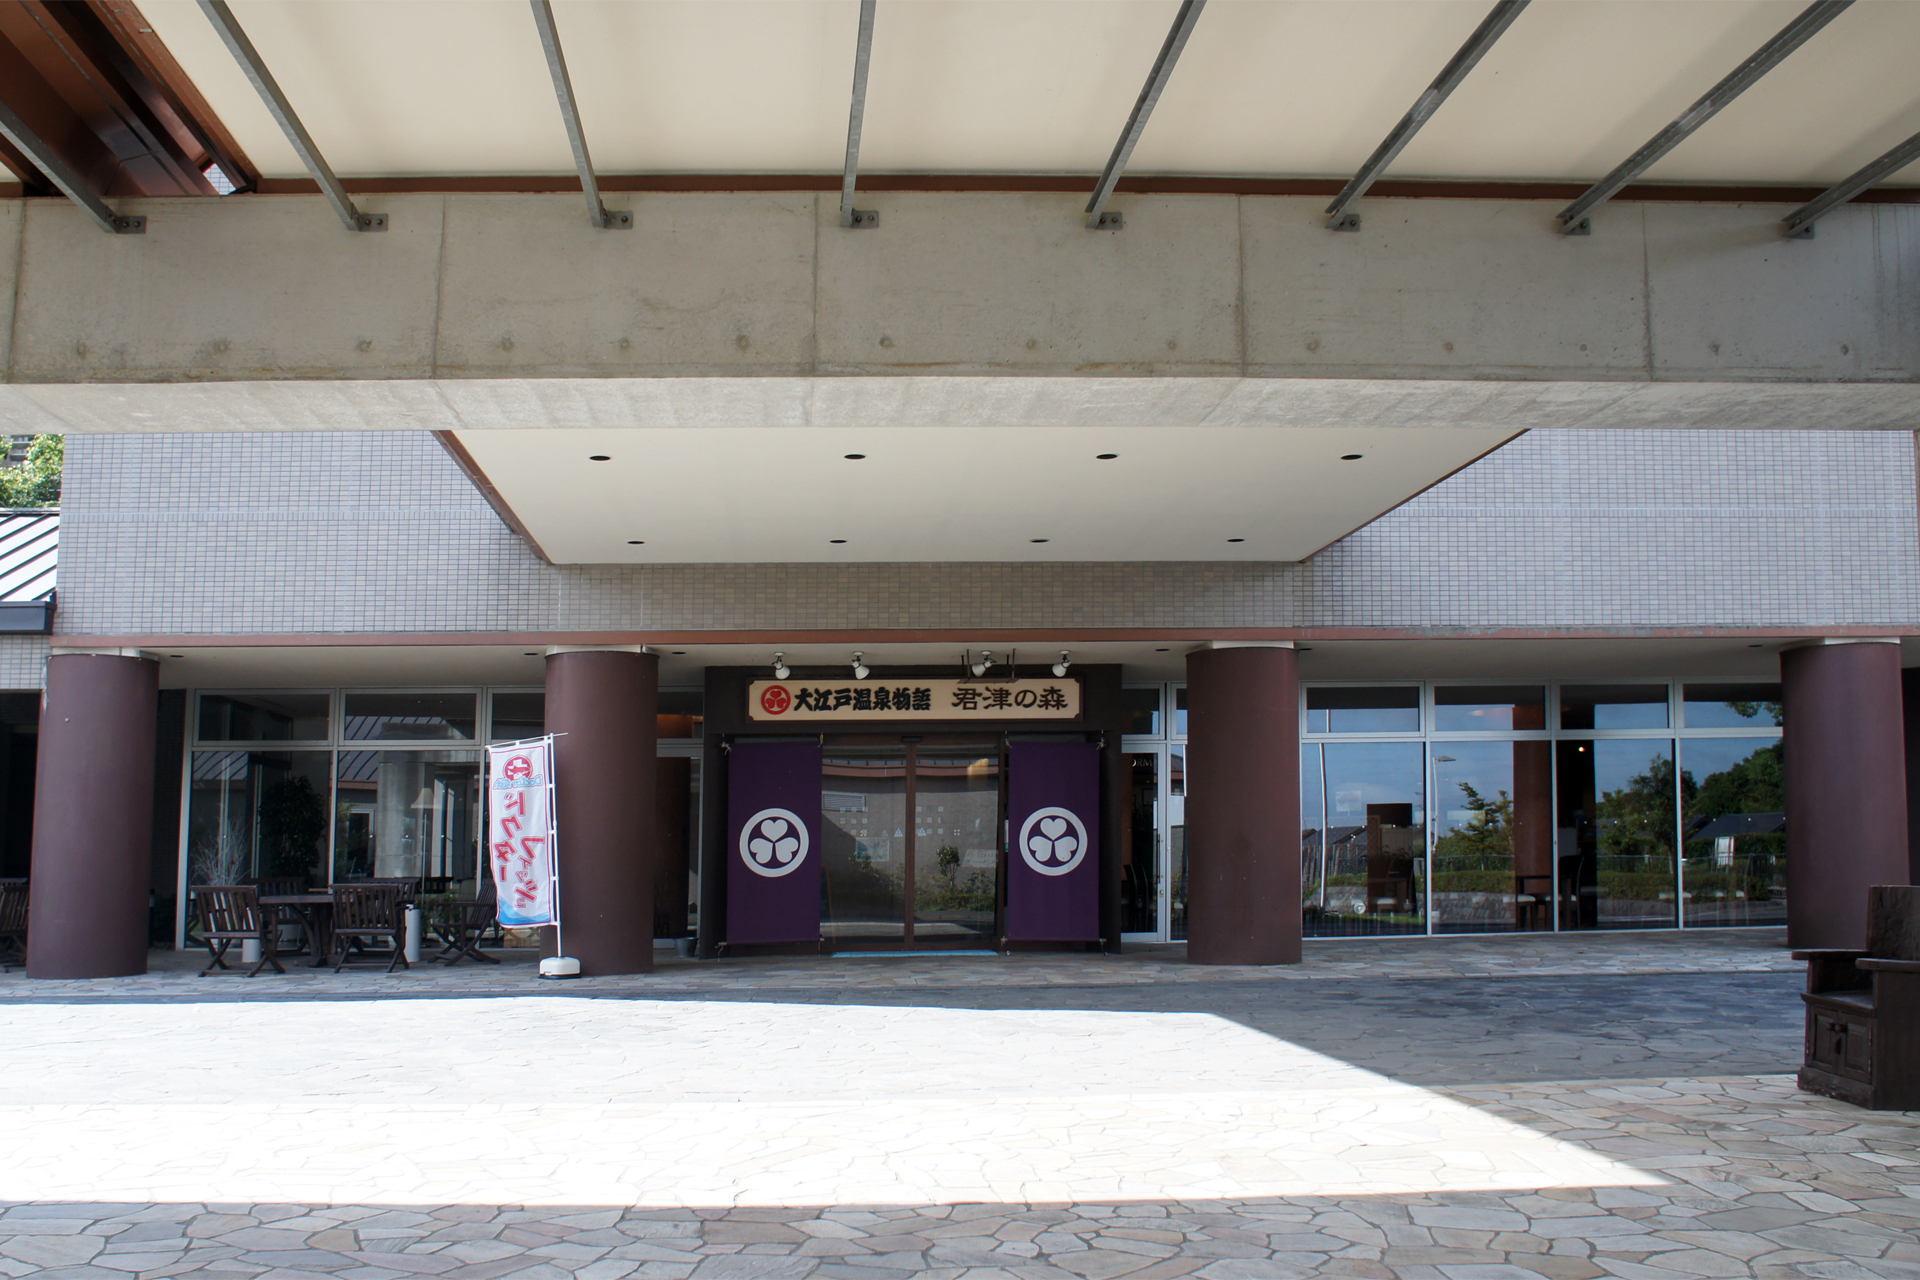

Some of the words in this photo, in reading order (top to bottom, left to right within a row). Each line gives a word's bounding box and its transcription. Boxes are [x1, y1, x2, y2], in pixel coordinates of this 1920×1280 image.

[794, 687, 931, 711] 大江戸温泉物語
[951, 686, 1068, 710] 君津の森
